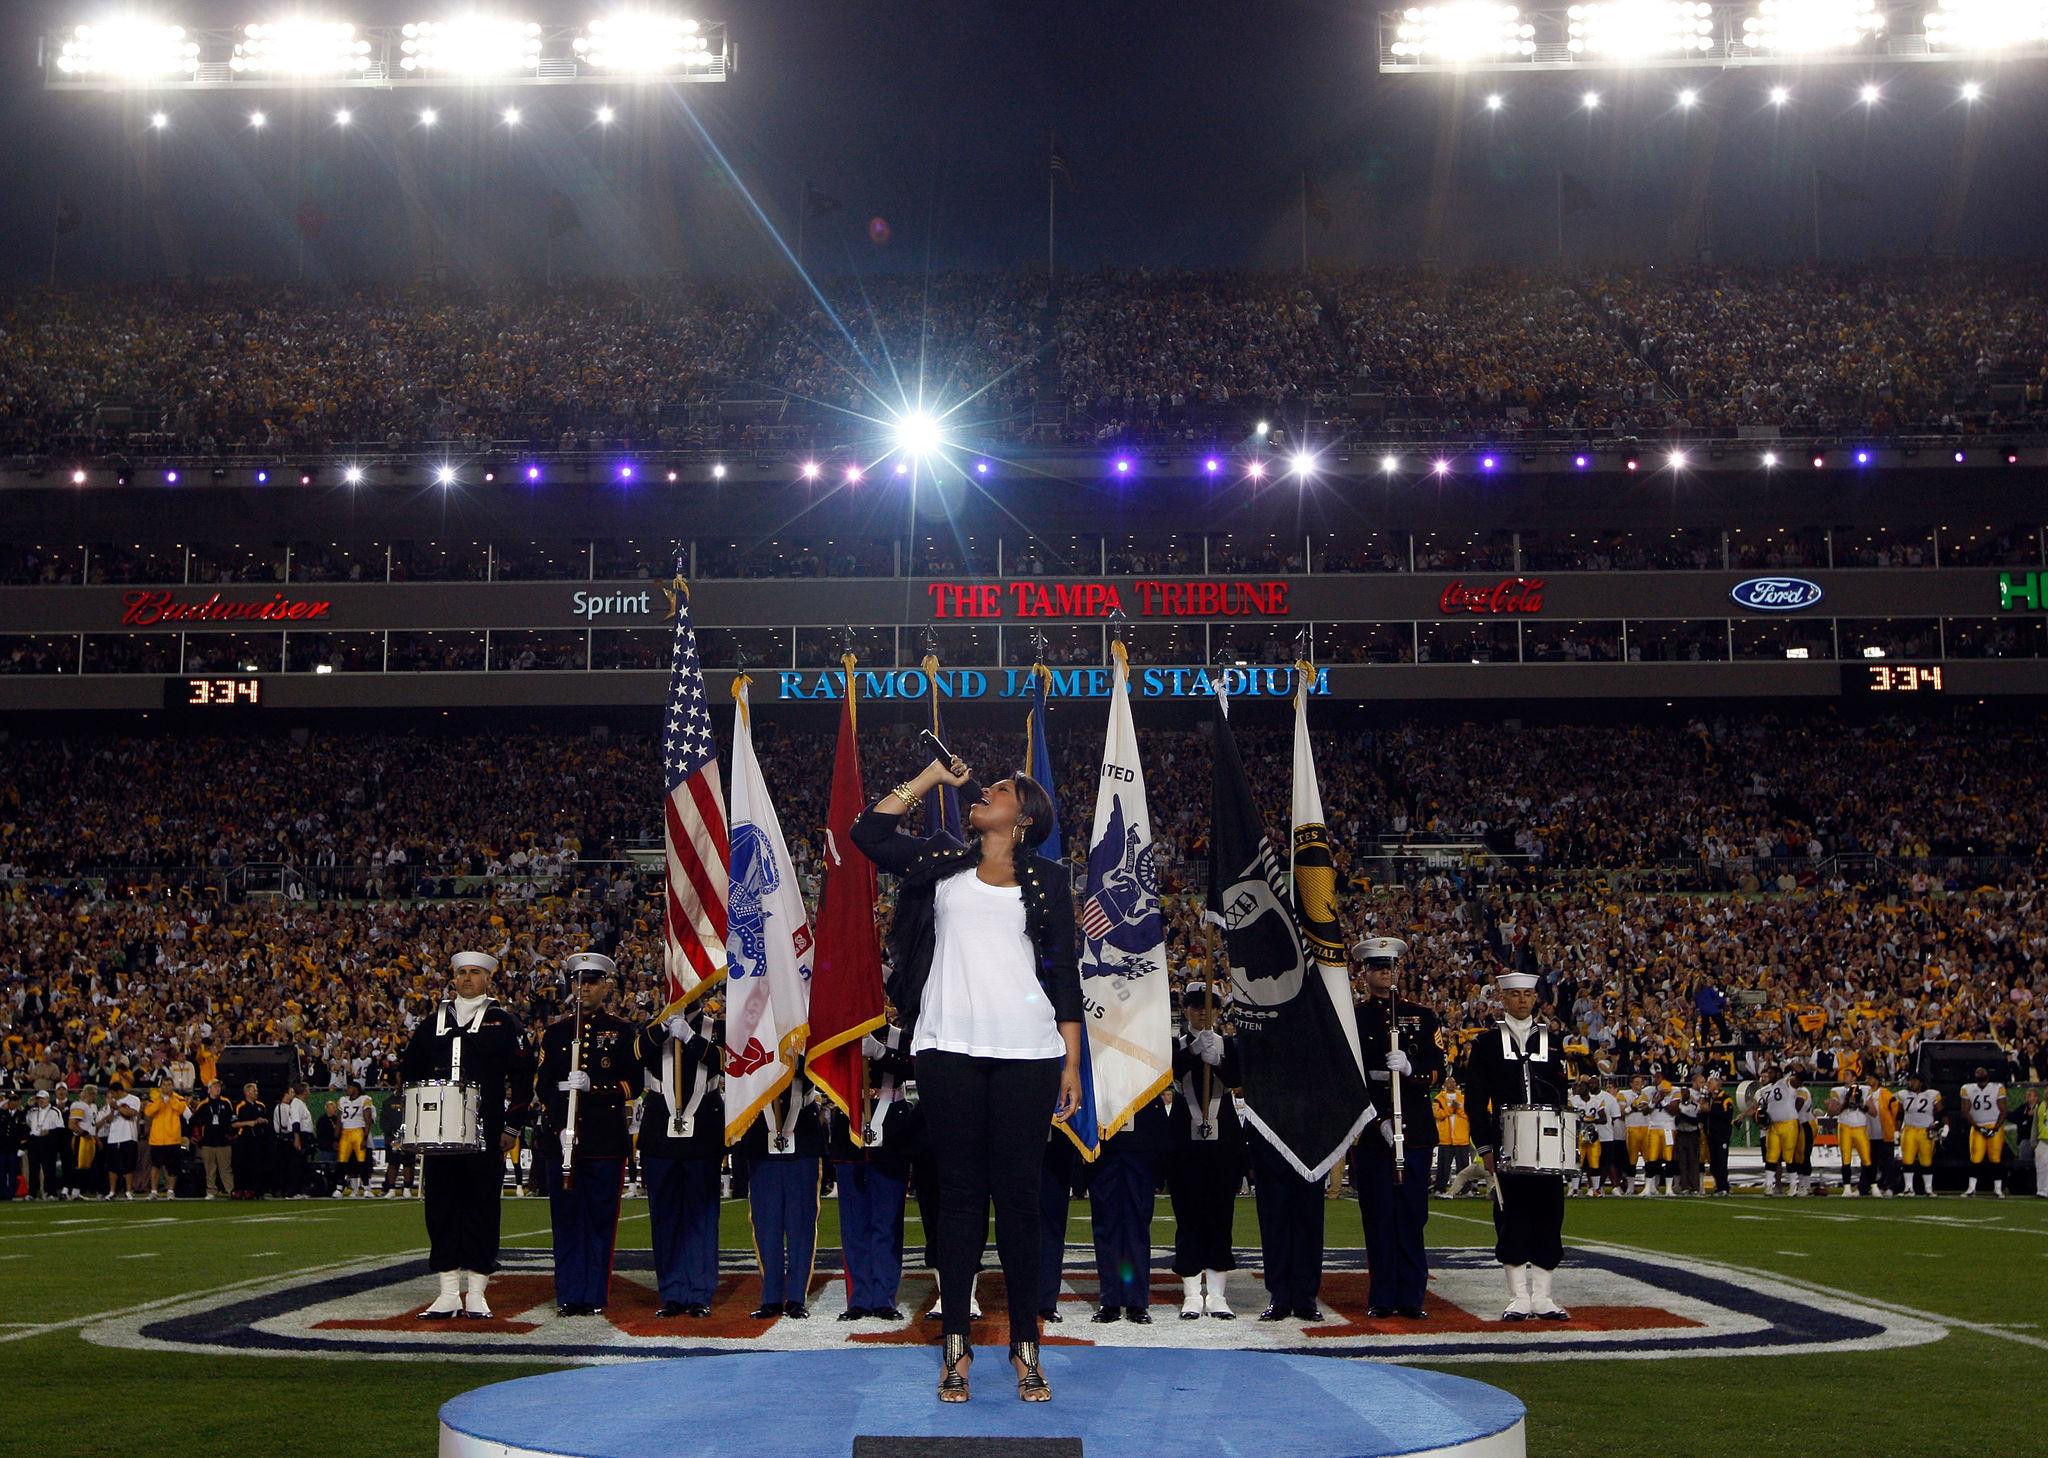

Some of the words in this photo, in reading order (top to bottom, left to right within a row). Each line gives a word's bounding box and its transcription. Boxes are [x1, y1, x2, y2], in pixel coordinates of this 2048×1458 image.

[928, 582, 1002, 618] THE
[1009, 582, 1122, 618] TAMPA
[1135, 581, 1290, 616] TRIBUNE
[1750, 581, 1803, 603] Ford
[121, 591, 331, 626] Budweiser
[573, 590, 650, 620] Sprint
[1869, 666, 1941, 690] 3:34
[189, 680, 258, 704] 3:34
[1766, 1087, 1782, 1101] 78
[1905, 1097, 1928, 1113] 72
[1973, 1095, 1992, 1110] 65
[343, 1106, 360, 1119] 57
